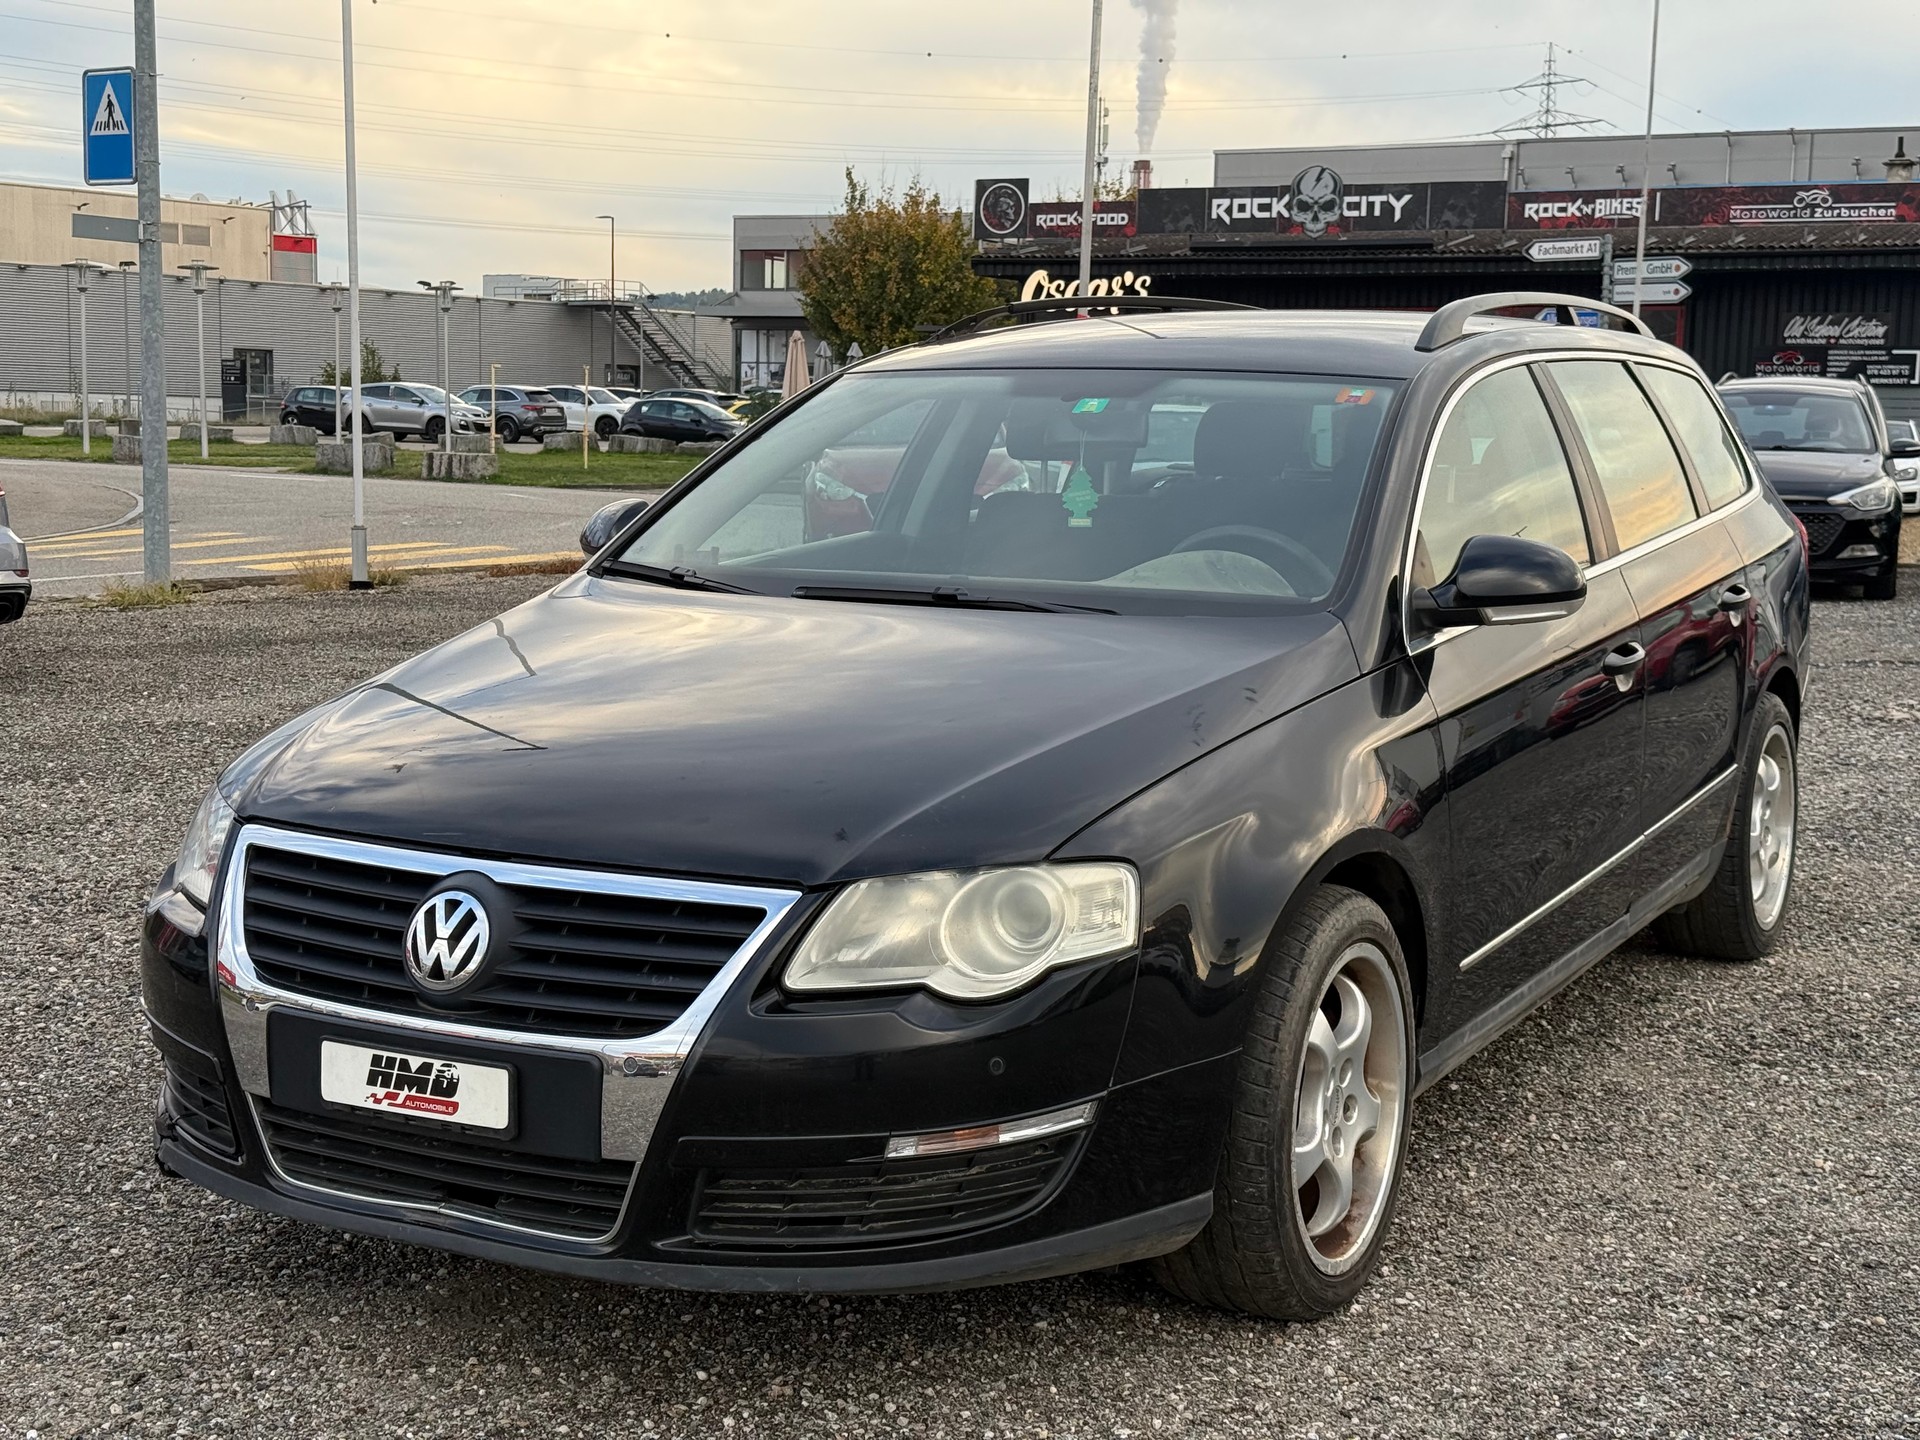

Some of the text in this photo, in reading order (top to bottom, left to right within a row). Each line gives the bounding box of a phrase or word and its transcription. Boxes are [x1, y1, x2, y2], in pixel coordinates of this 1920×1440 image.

[1211, 193, 1413, 225] ROCK CITY
[1729, 206, 1896, 219] MotoWorld Zurbuchen
[1537, 244, 1584, 256] Fachmarkt
[1646, 262, 1673, 274] GmbH
[1755, 364, 1821, 373] MotoWorld
[405, 1099, 454, 1114] AUTOMOBILE
